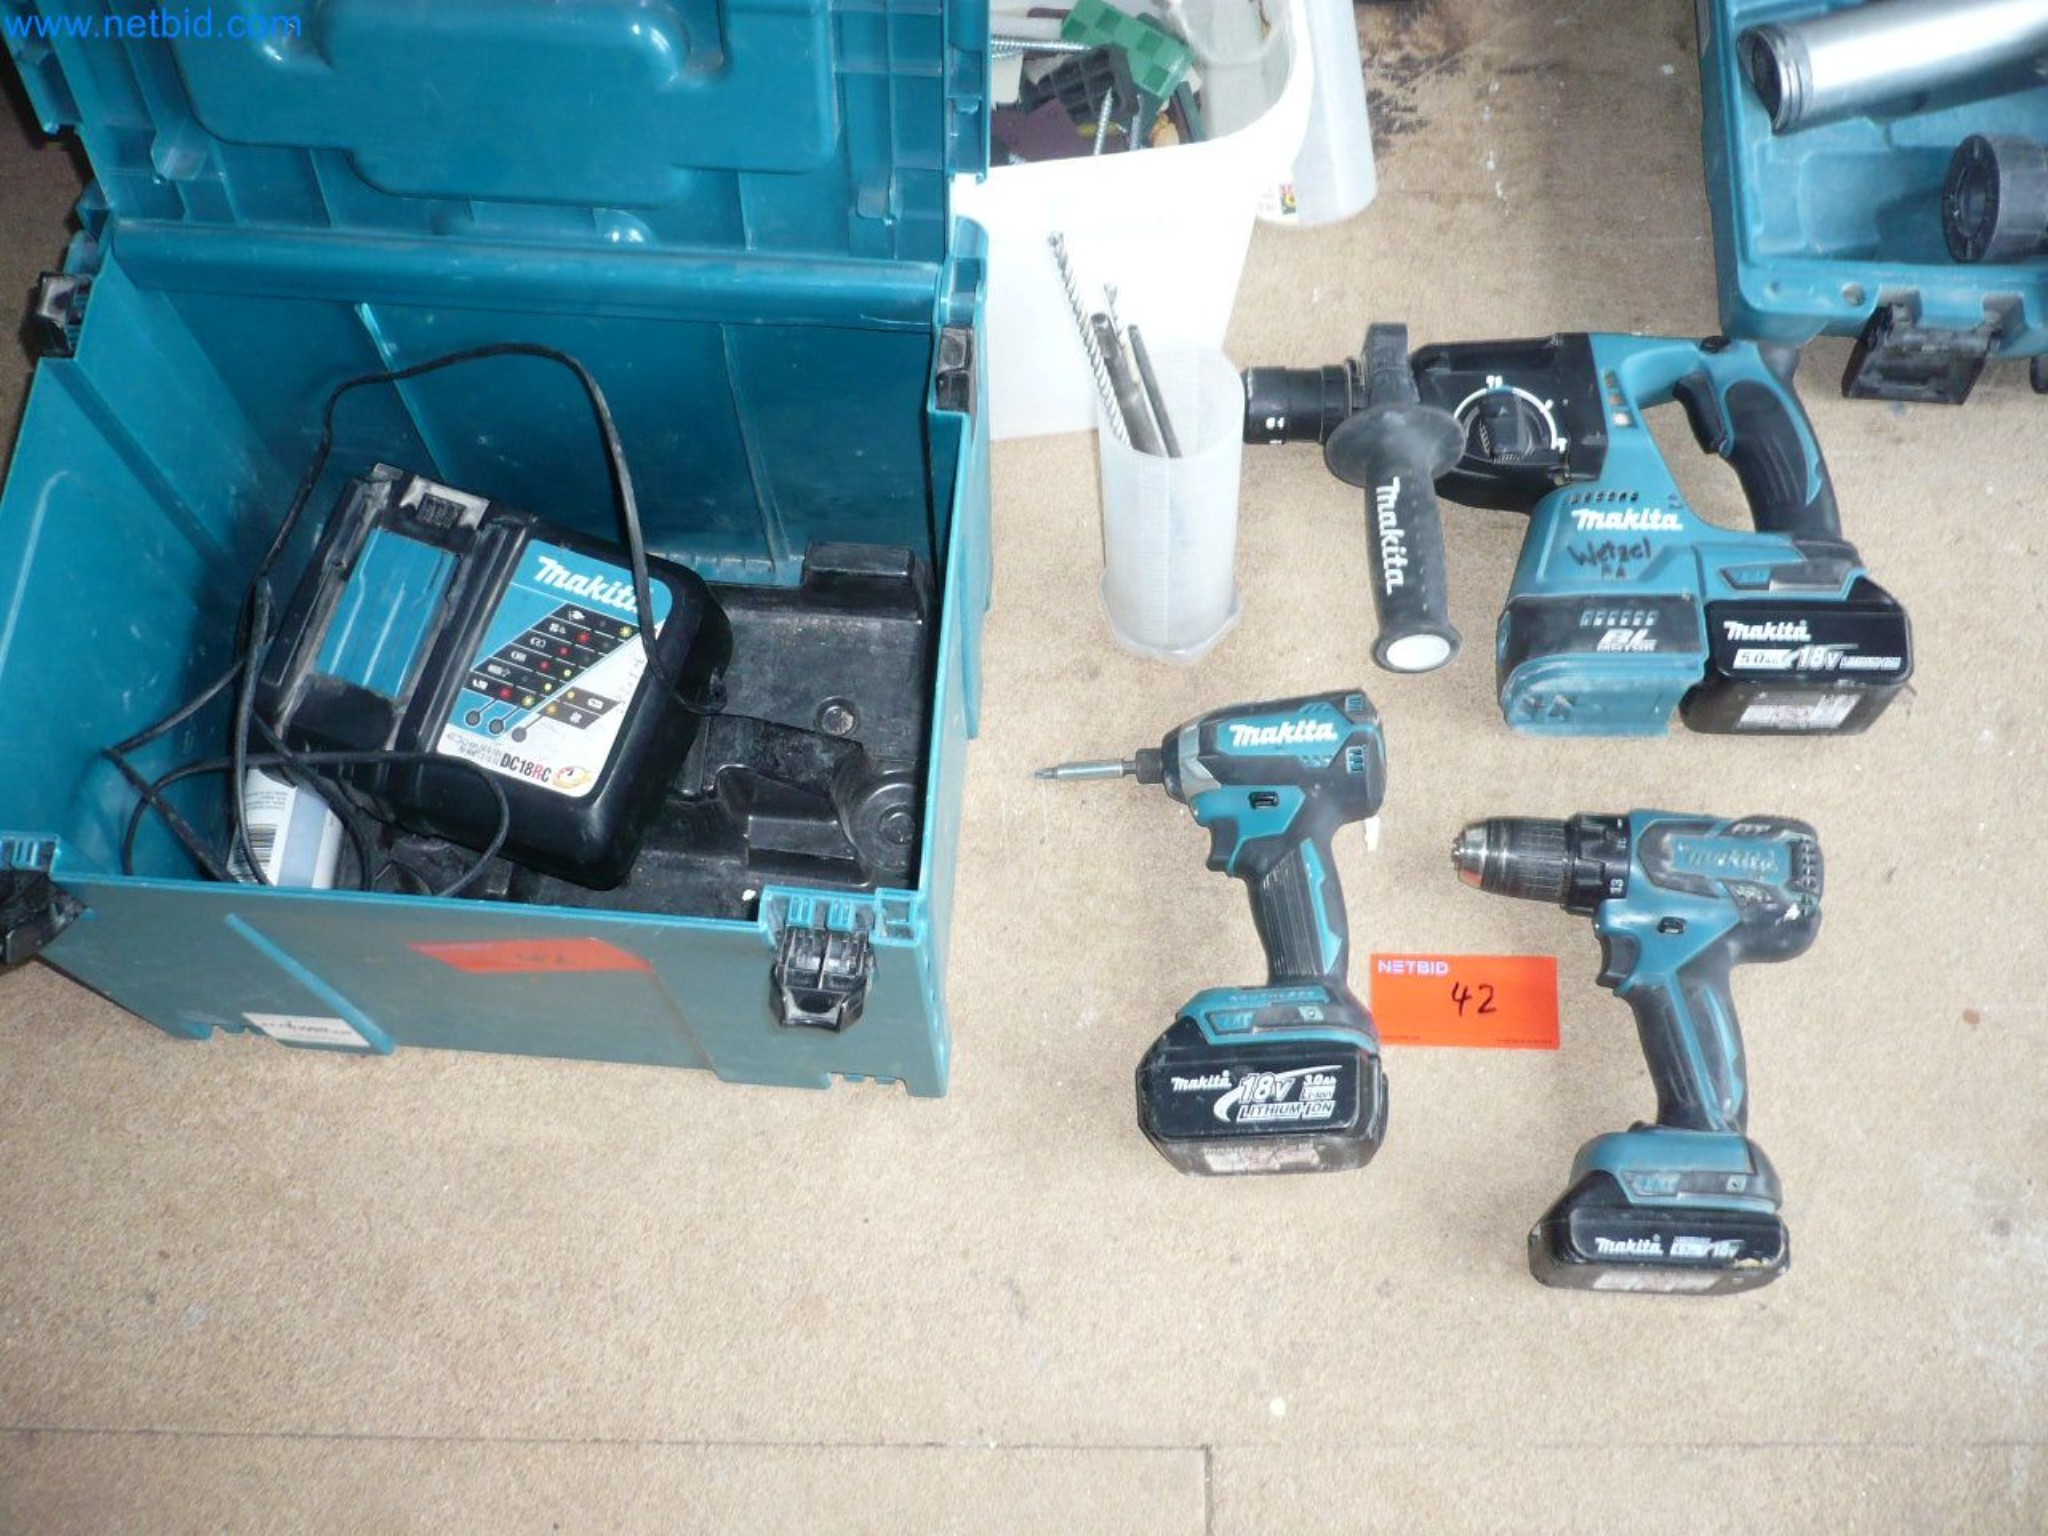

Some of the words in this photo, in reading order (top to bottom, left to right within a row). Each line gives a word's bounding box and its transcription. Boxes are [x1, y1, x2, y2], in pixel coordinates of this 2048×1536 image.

[500, 752, 551, 783] DC18RC
[1377, 959, 1449, 976] NETBID
[1451, 981, 1498, 1016] 42
